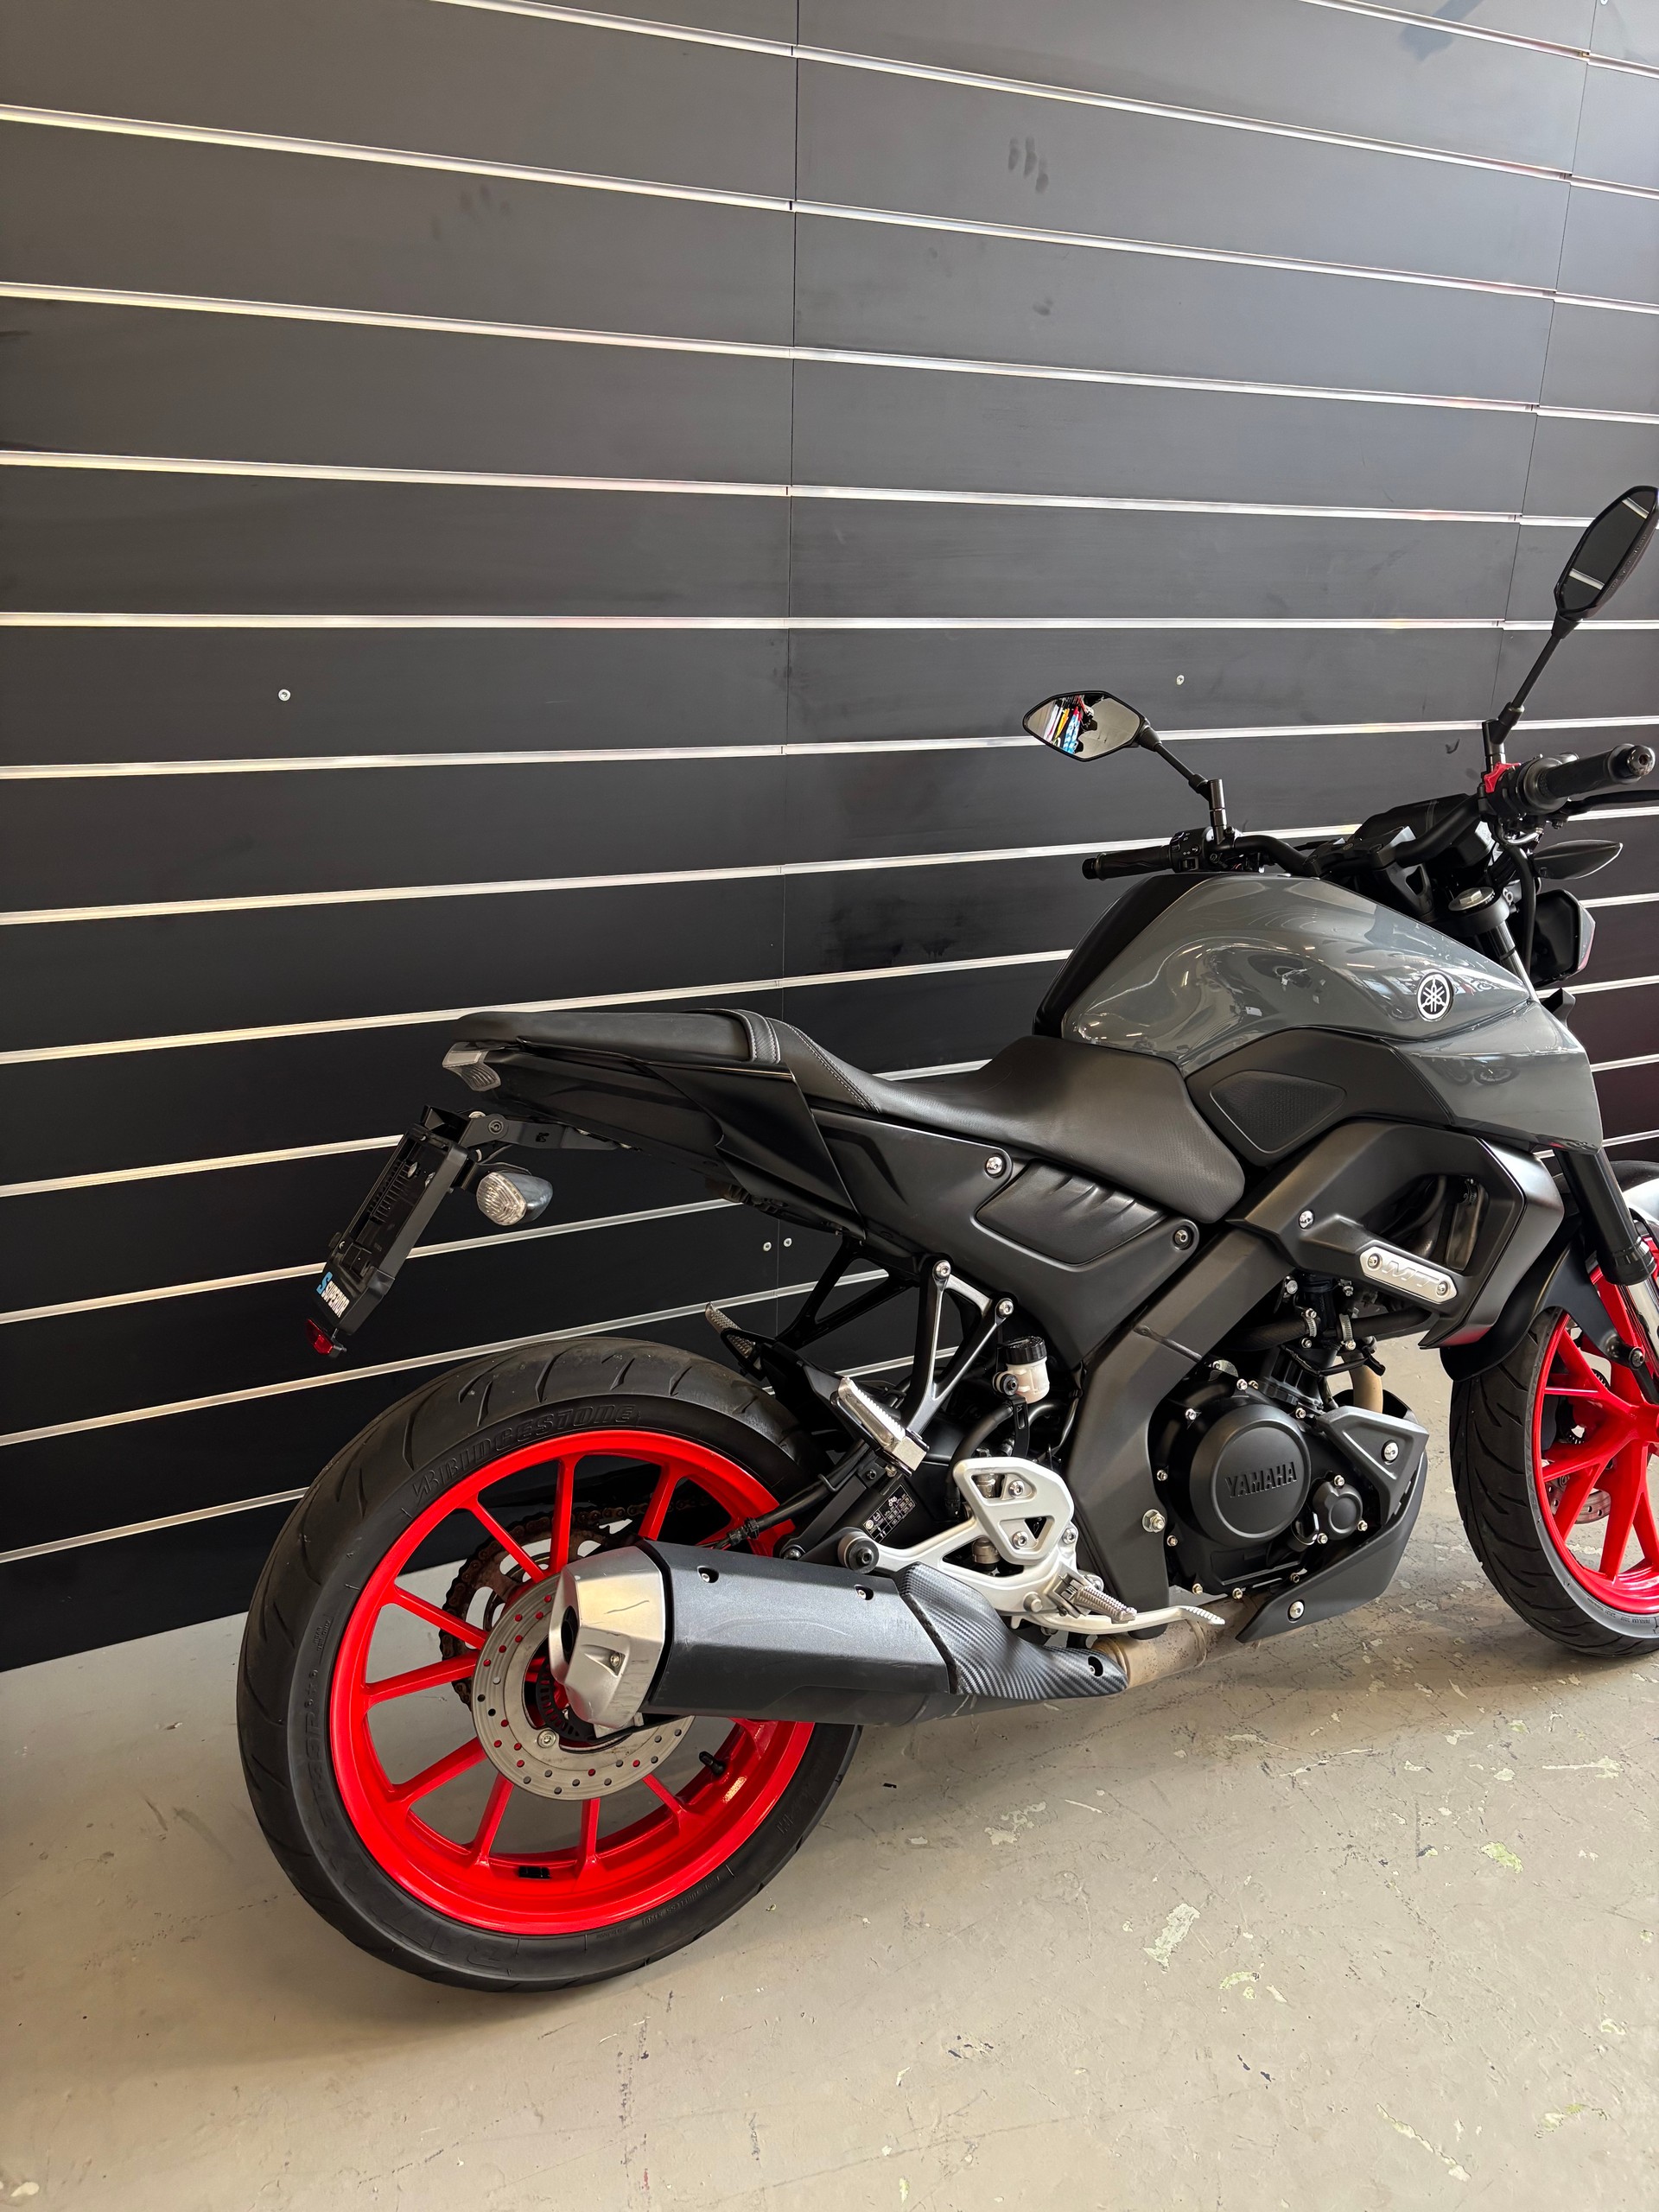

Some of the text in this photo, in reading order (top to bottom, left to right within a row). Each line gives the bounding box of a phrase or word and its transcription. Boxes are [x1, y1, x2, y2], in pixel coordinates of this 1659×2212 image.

[321, 1280, 350, 1318] SUPERIOR
[412, 1403, 637, 1503] BRIDGESTONE
[1224, 1461, 1297, 1498] YAMAHA
